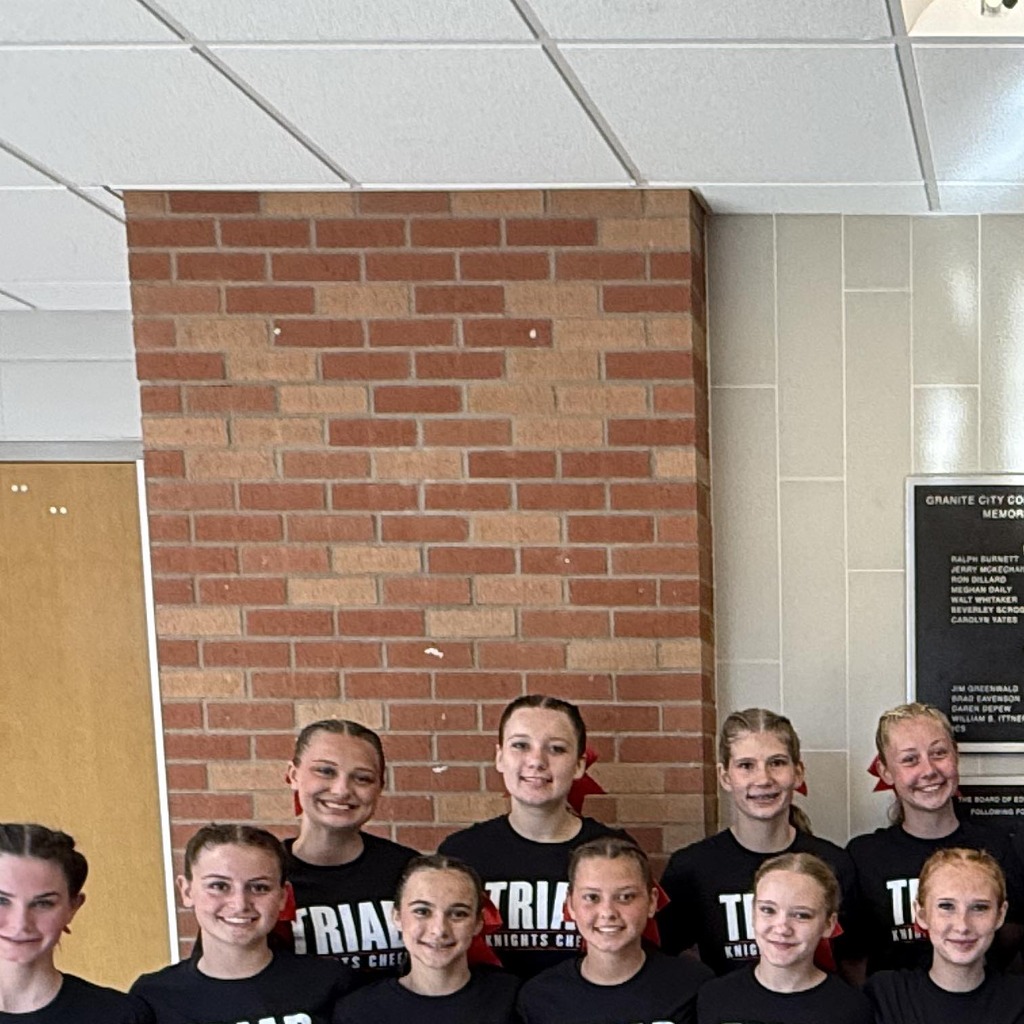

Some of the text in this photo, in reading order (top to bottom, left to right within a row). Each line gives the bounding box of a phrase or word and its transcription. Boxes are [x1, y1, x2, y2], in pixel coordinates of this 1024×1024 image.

[925, 495, 975, 505] GRANITE
[978, 495, 1004, 505] CITY
[951, 555, 1019, 563] RALPH BURNETT
[951, 565, 977, 573] JERRY
[951, 616, 1018, 624] CAROLYN YATES
[951, 714, 985, 722] WILLIAM
[485, 881, 576, 931] TRIA
[485, 933, 581, 947] KNIGHTS CHE
